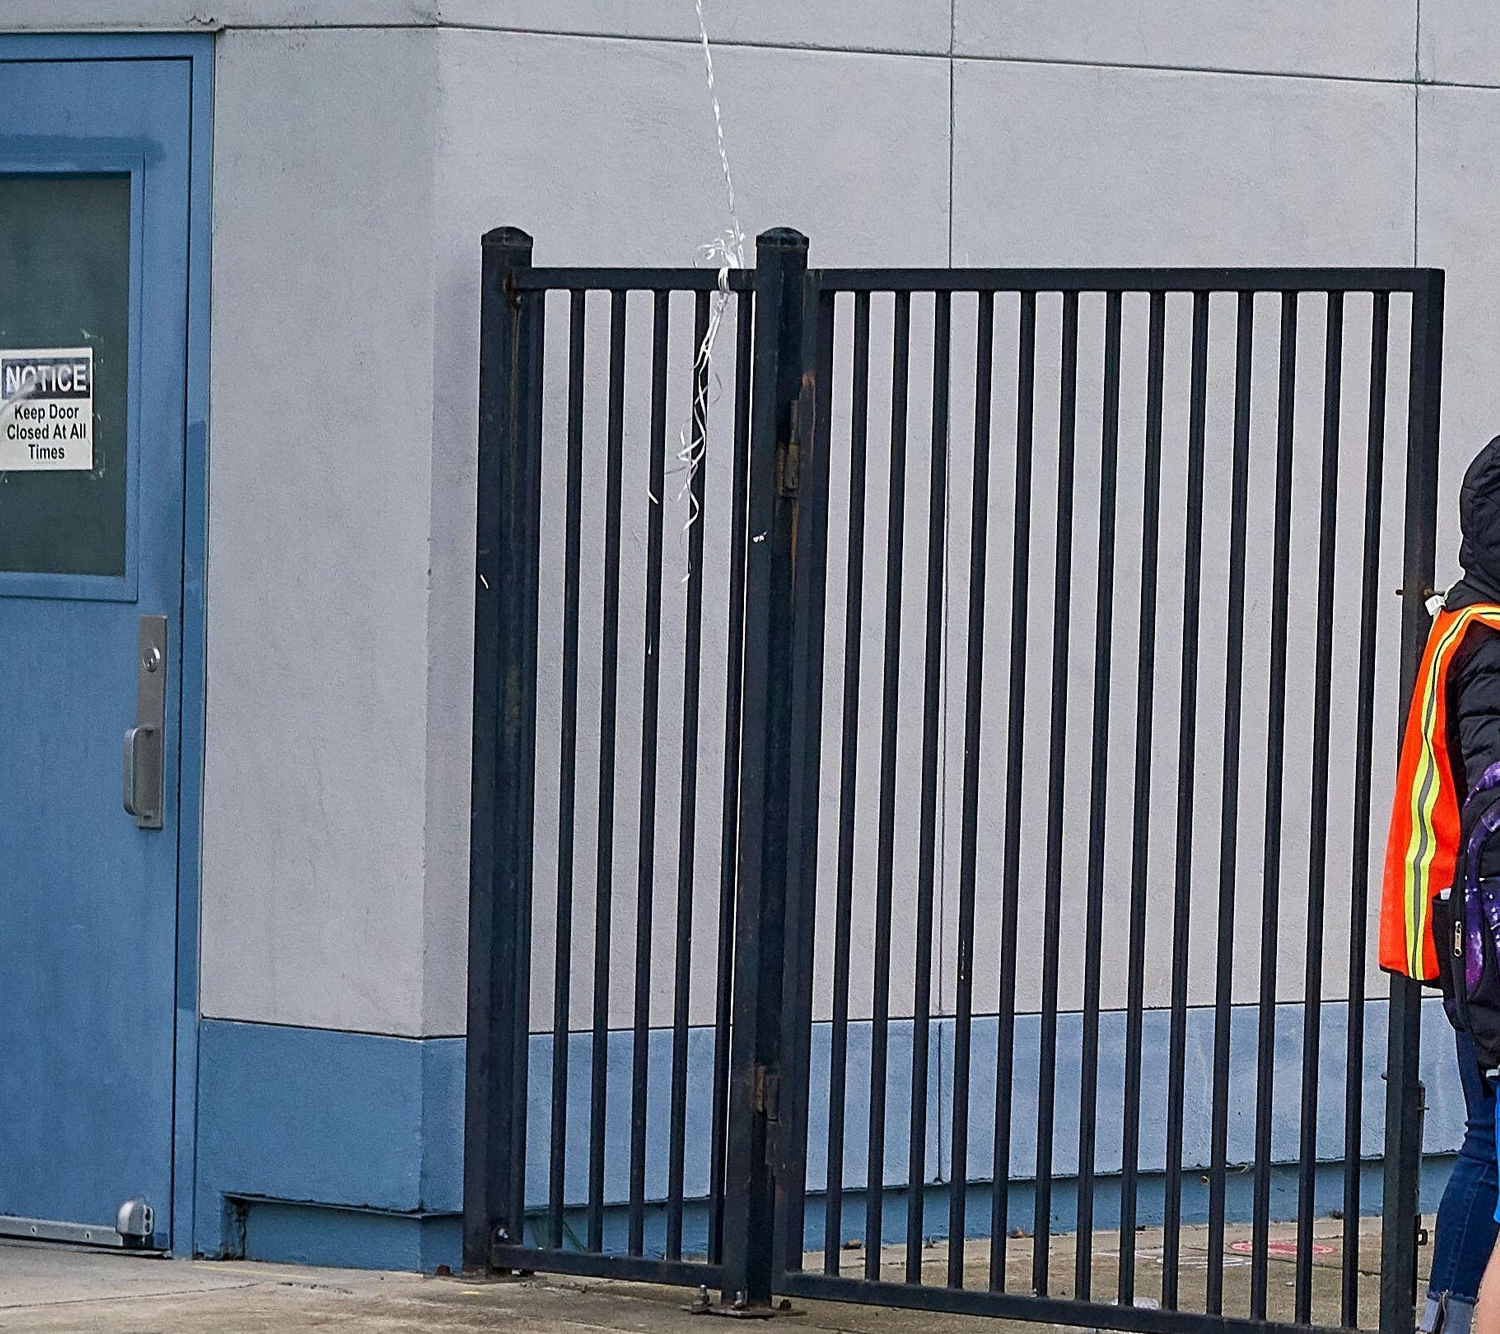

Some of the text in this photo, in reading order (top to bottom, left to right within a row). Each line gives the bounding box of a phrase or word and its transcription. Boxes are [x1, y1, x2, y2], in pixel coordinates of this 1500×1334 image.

[5, 364, 87, 394] NOTICE
[14, 404, 79, 423] Keep Door
[7, 423, 86, 440] Closed At All
[28, 444, 65, 460] Times
